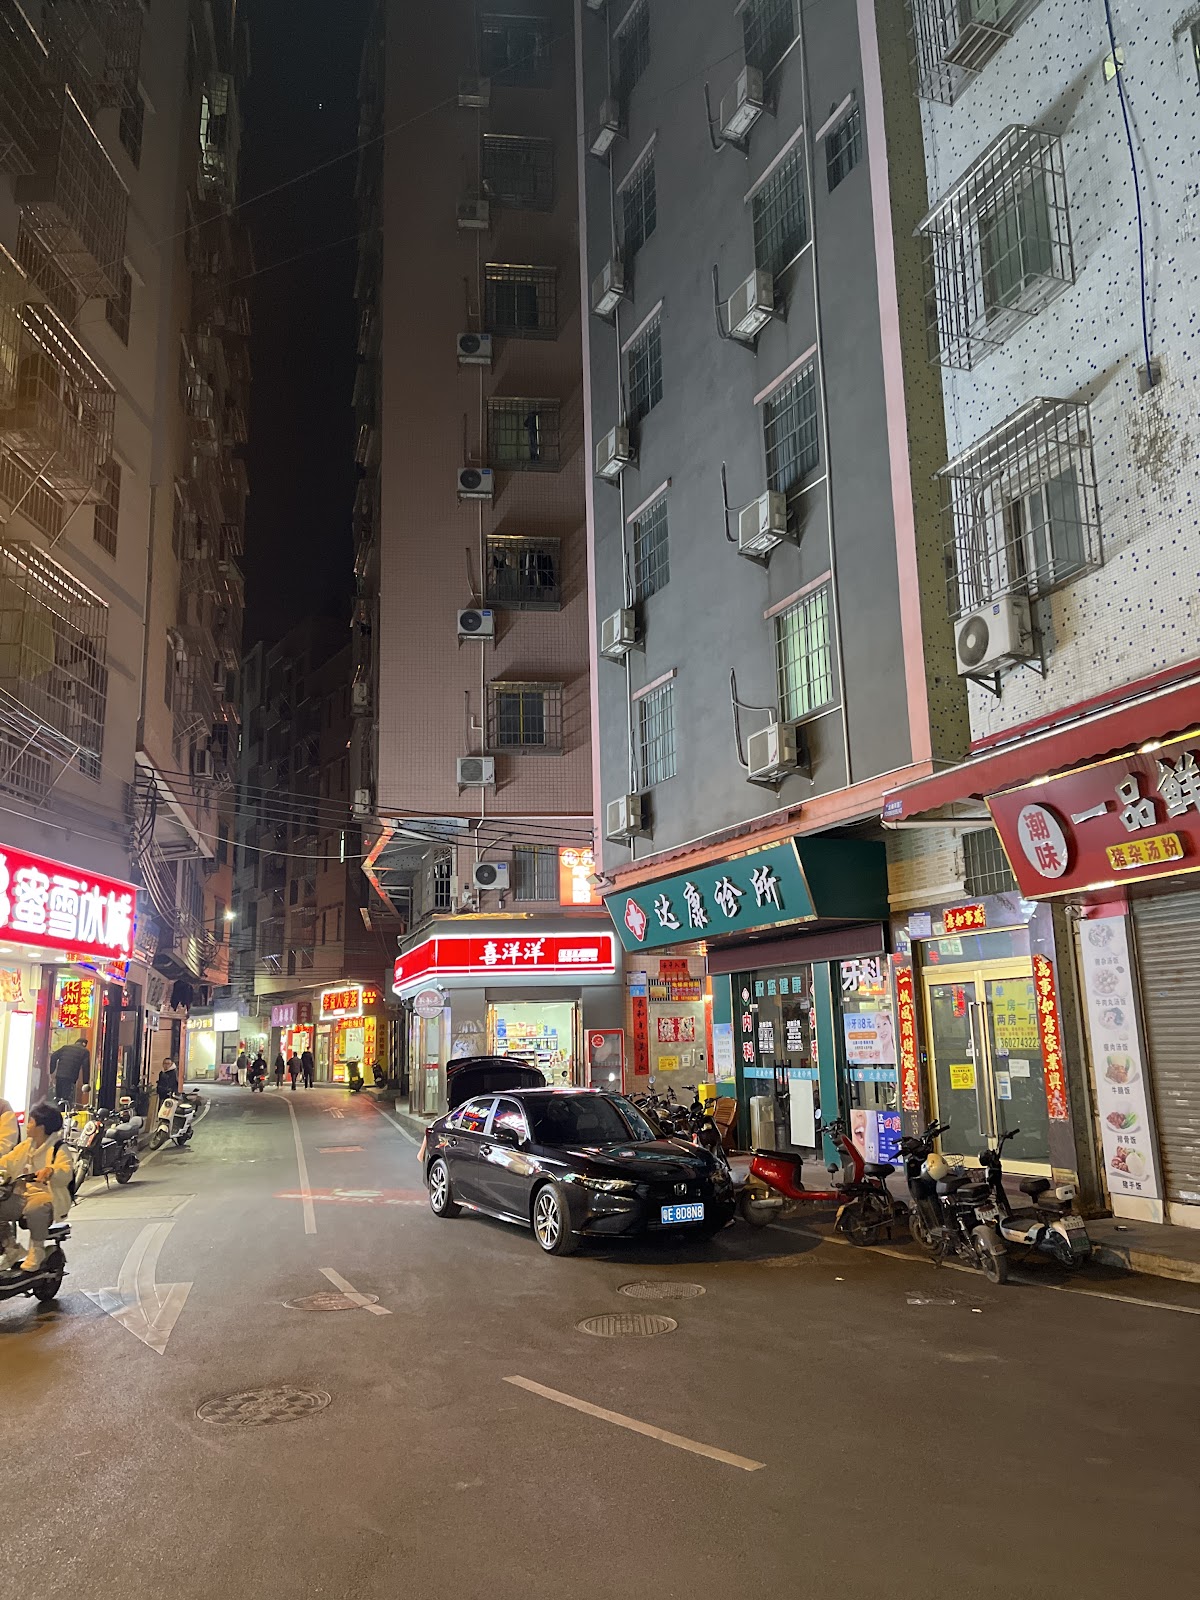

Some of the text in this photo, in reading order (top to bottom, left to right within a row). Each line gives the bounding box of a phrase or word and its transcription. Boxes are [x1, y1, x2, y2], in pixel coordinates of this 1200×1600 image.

[1071, 752, 1200, 832] 一品鲜
[1023, 811, 1062, 871] 潮味
[1111, 836, 1180, 868] 猪杂汤粉
[654, 865, 781, 931] 达康诊所
[479, 937, 545, 966] 喜洋洋
[755, 976, 802, 997] 祝您健康
[841, 956, 883, 992] 牙科
[62, 980, 80, 1026] 化州糖水
[995, 999, 1036, 1012] 一房一厅
[1095, 997, 1127, 1007] 牛肉丸汤饭
[996, 1013, 1038, 1026] 两房一厅
[742, 1012, 755, 1062] 内科
